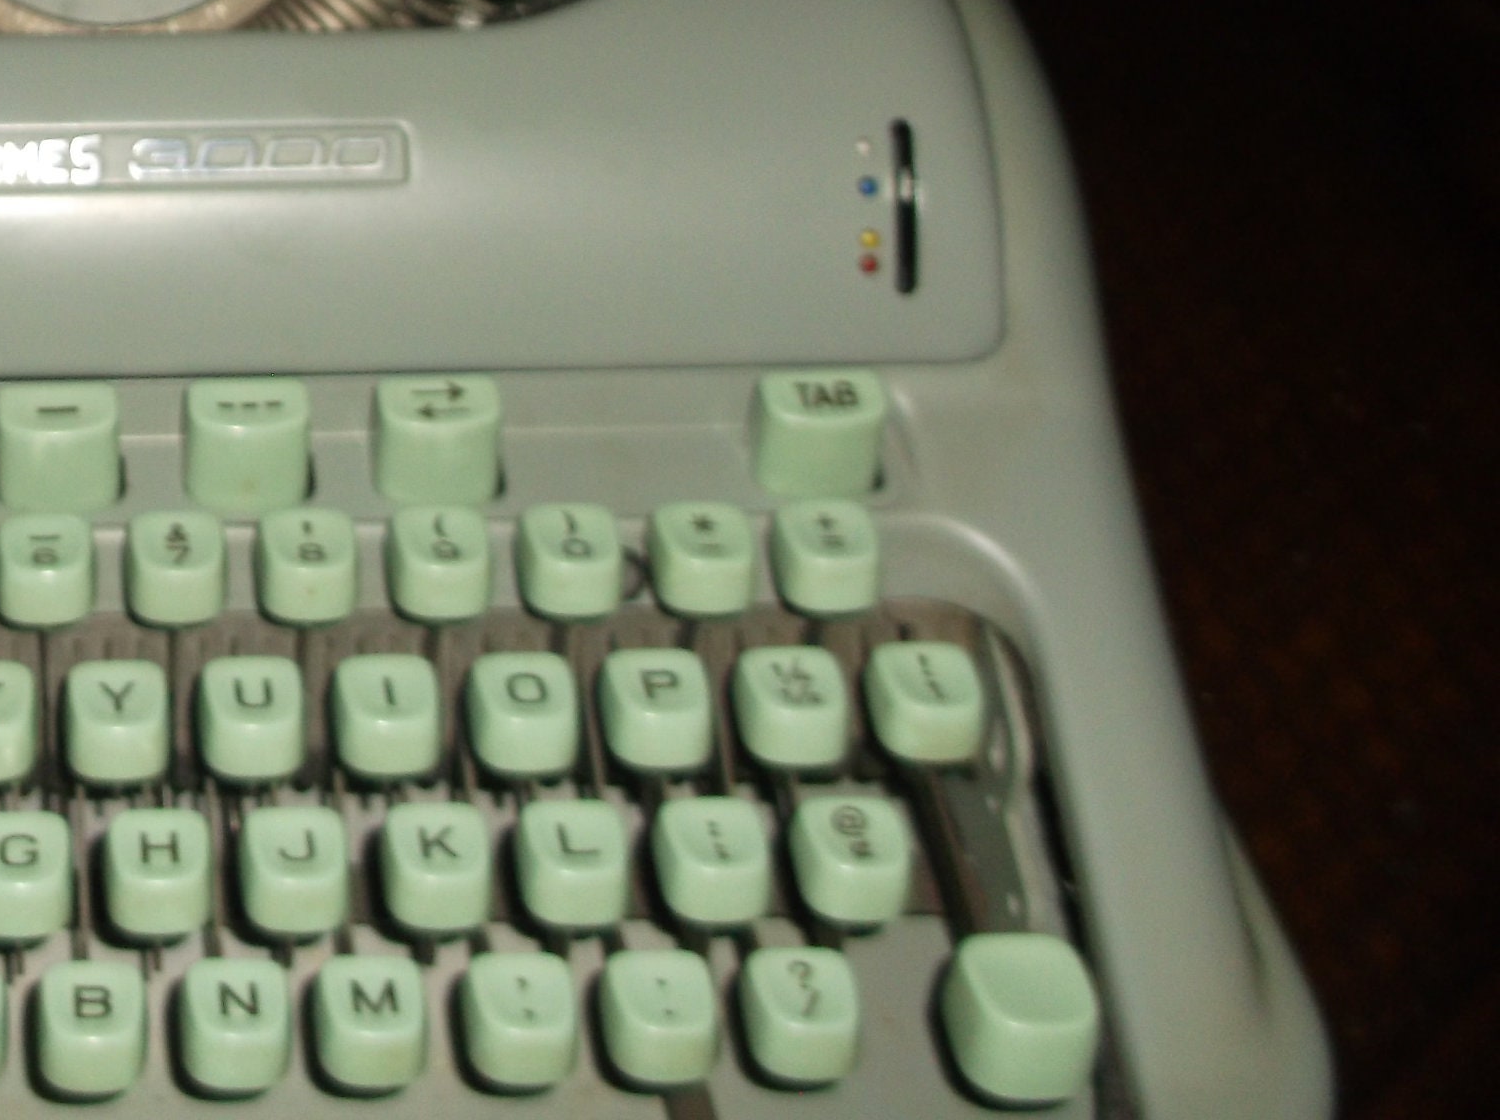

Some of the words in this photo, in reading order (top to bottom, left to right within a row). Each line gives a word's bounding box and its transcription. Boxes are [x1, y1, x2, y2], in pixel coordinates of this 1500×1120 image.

[794, 379, 860, 411] TAB
[101, 683, 133, 717] Y
[234, 679, 274, 710] U
[383, 678, 397, 710] I
[505, 673, 550, 708] O
[641, 670, 680, 703] P
[140, 833, 181, 866] H
[278, 830, 318, 868] J
[418, 828, 459, 862] K
[557, 824, 600, 861] L
[73, 986, 113, 1022] B
[218, 983, 261, 1019] N
[351, 981, 400, 1016] M
